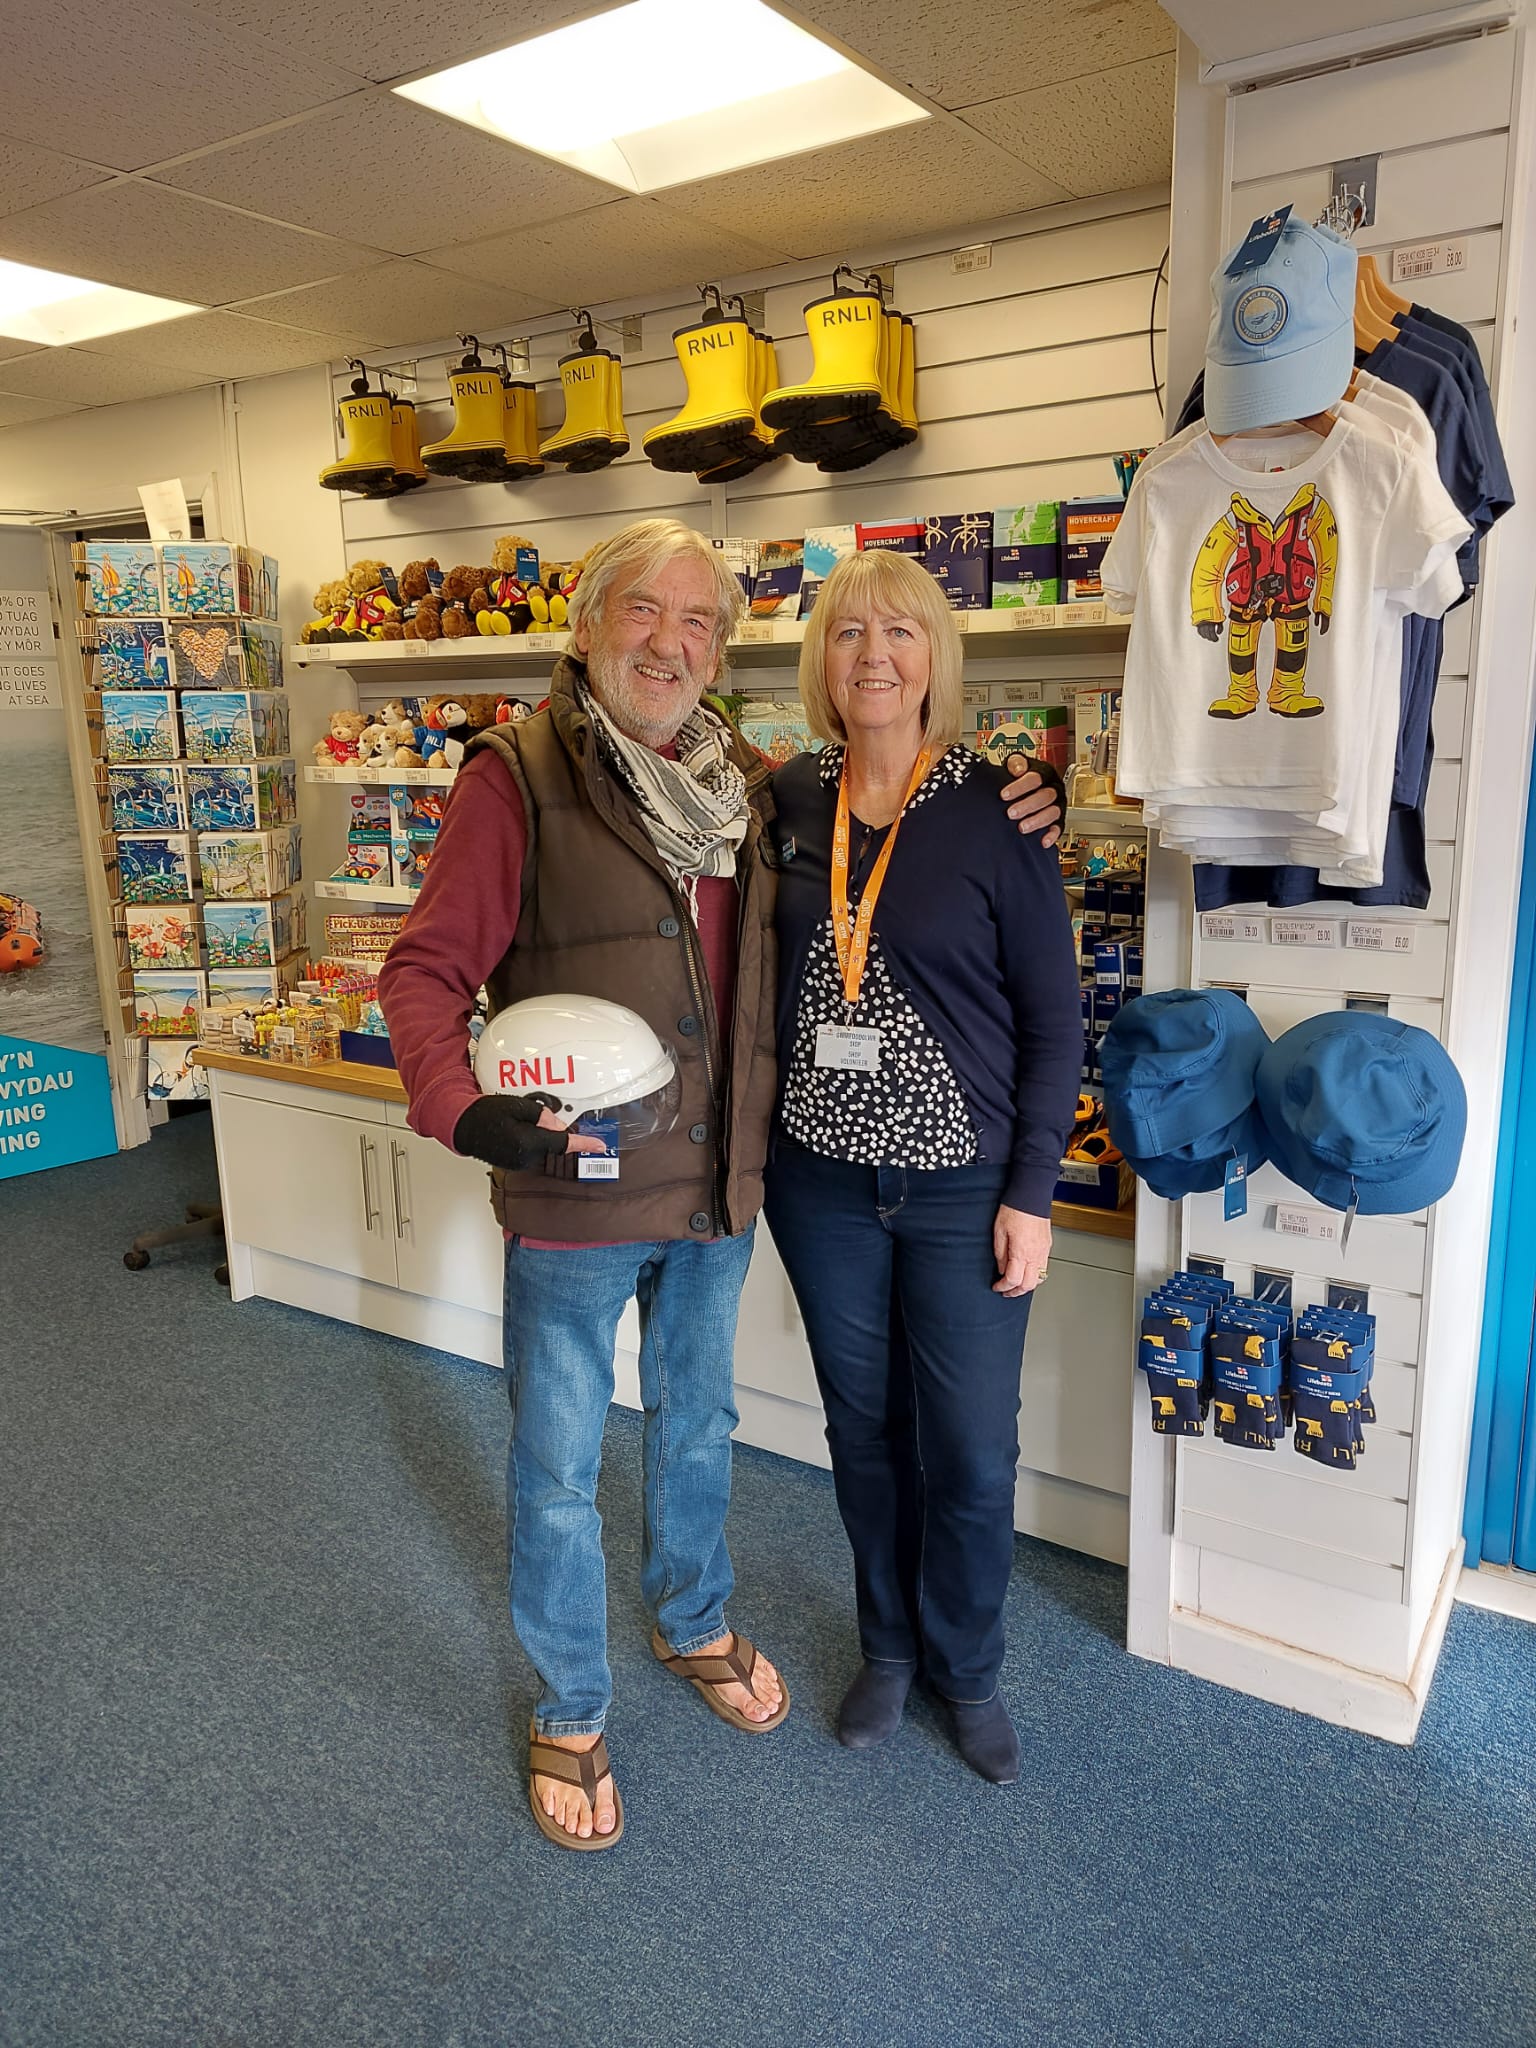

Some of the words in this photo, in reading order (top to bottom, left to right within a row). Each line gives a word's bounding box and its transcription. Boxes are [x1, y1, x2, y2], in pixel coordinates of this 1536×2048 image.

[823, 305, 872, 327] RNLI
[688, 331, 734, 356] RNLI
[564, 364, 596, 385] RNLI
[456, 380, 493, 397] RNLI
[348, 403, 385, 419] RNLI
[1069, 515, 1116, 525] HOVERCRAFT
[863, 537, 905, 549] HOVERCRAFT
[16, 596, 37, 608] O'R
[7, 611, 38, 622] TUAG
[16, 638, 42, 651] MÔR
[14, 666, 46, 677] GOES
[15, 681, 47, 691] LIVES
[9, 695, 23, 705] AT
[26, 695, 49, 705] SEA
[834, 848, 847, 869] SHOP
[499, 1055, 575, 1088] RNLI
[1154, 1354, 1178, 1364] Lifeboats
[1225, 1369, 1249, 1381] Lifeboats
[1306, 1377, 1333, 1388] Lifeboats
